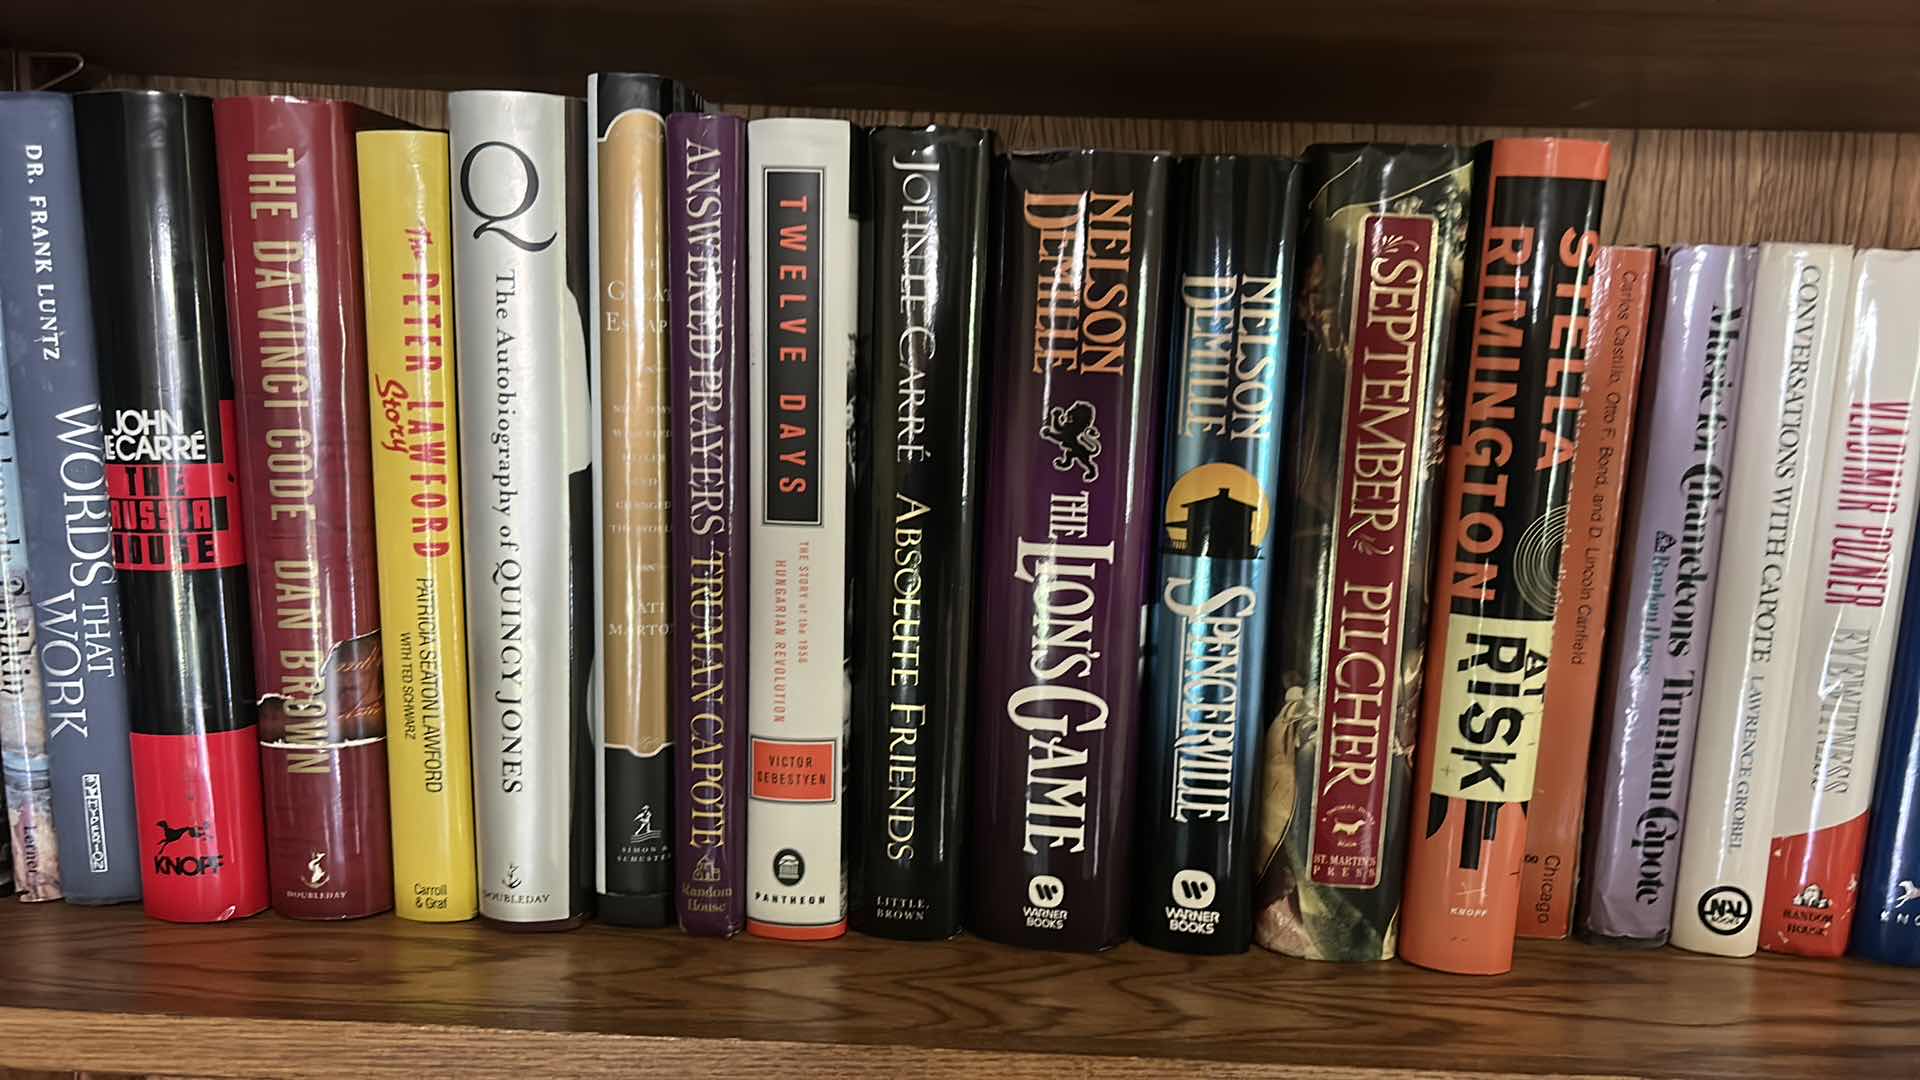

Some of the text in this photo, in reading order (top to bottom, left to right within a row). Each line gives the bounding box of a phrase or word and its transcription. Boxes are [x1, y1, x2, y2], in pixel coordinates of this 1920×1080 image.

[460, 140, 558, 253] Q
[892, 154, 940, 259] JOHN
[24, 144, 61, 361] DR. FRANK LUNTZ
[1024, 189, 1086, 375] DEMILLE
[1080, 190, 1135, 377] NELSON
[1615, 270, 1638, 321] Carlos
[246, 147, 318, 521] THE DA VINCI CODE
[779, 195, 808, 494] TWELVE DAYS
[1181, 272, 1238, 440] DEMILLE
[1230, 273, 1283, 441] NELSON
[1535, 226, 1598, 472] STELLA
[1699, 304, 1742, 405] Music
[111, 409, 184, 436] JOHN
[374, 373, 410, 454] Story
[401, 272, 450, 559] PETER LAWFORD
[896, 325, 937, 463] CARRÉ
[1346, 257, 1425, 538] SEPTEMBER
[1451, 226, 1537, 600] RIMINGTON
[1601, 391, 1621, 423] Otto
[124, 466, 187, 497] THE
[685, 137, 726, 848] ANSWERED PRAYERS TRUMAN CAPOTE
[1751, 264, 1822, 663] CONVERSATIONS WITH CAPOTE
[1838, 401, 1912, 513] VLADIMIR
[55, 402, 117, 679] WORDS THAT
[111, 499, 214, 530] RUSSIA
[113, 533, 218, 565] HOUSE
[491, 269, 523, 794] The Autobiography of QUINCY JONES
[797, 541, 809, 561] THE
[1590, 494, 1608, 520] and
[797, 566, 809, 600] STORY
[1580, 546, 1601, 600] Lincoln
[1646, 555, 1671, 622] Random
[1667, 462, 1724, 658] Chameleons
[1824, 523, 1894, 609] POZNER
[35, 589, 88, 740] WORK
[273, 562, 331, 774] DAN BROWN
[400, 632, 417, 740] WITH TED SCHWARZ
[415, 577, 444, 793] PATRICIA SEATON LAWFORD
[773, 560, 788, 724] HUNGARIAN REVOLUTION
[886, 491, 932, 861] ABSOLUTE FRIENDS
[1006, 489, 1115, 855] THE LION'S GAME
[1323, 580, 1394, 797] PILCHER
[1523, 647, 1549, 704] AT
[1163, 576, 1258, 823] SPENCERVILLE
[1449, 631, 1529, 792] RISK
[756, 771, 827, 786] SEBESTYEN
[768, 755, 815, 768] VICTOR
[1631, 669, 1697, 905] Truman Capote
[1727, 674, 1766, 850] LAWRENCE GROBEL
[153, 854, 225, 878] KNOPF
[286, 890, 348, 901] DOUBLEDAY
[414, 883, 448, 896] Carroll
[425, 897, 448, 910] Graf
[482, 889, 551, 904] DOUBLEDAY
[682, 881, 733, 898] Random
[687, 898, 727, 913] House
[754, 891, 827, 905] PANTHEON
[1023, 905, 1069, 920] WARNER
[1312, 866, 1377, 878] PRESS
[1449, 907, 1488, 917] KNOPF
[1535, 854, 1561, 924] Chicago
[876, 909, 925, 921] BROWN
[1025, 916, 1065, 929] BOOKS
[1165, 906, 1220, 923] WARNER
[1168, 918, 1215, 935] BOOKS
[1782, 910, 1833, 923] RANDOM
